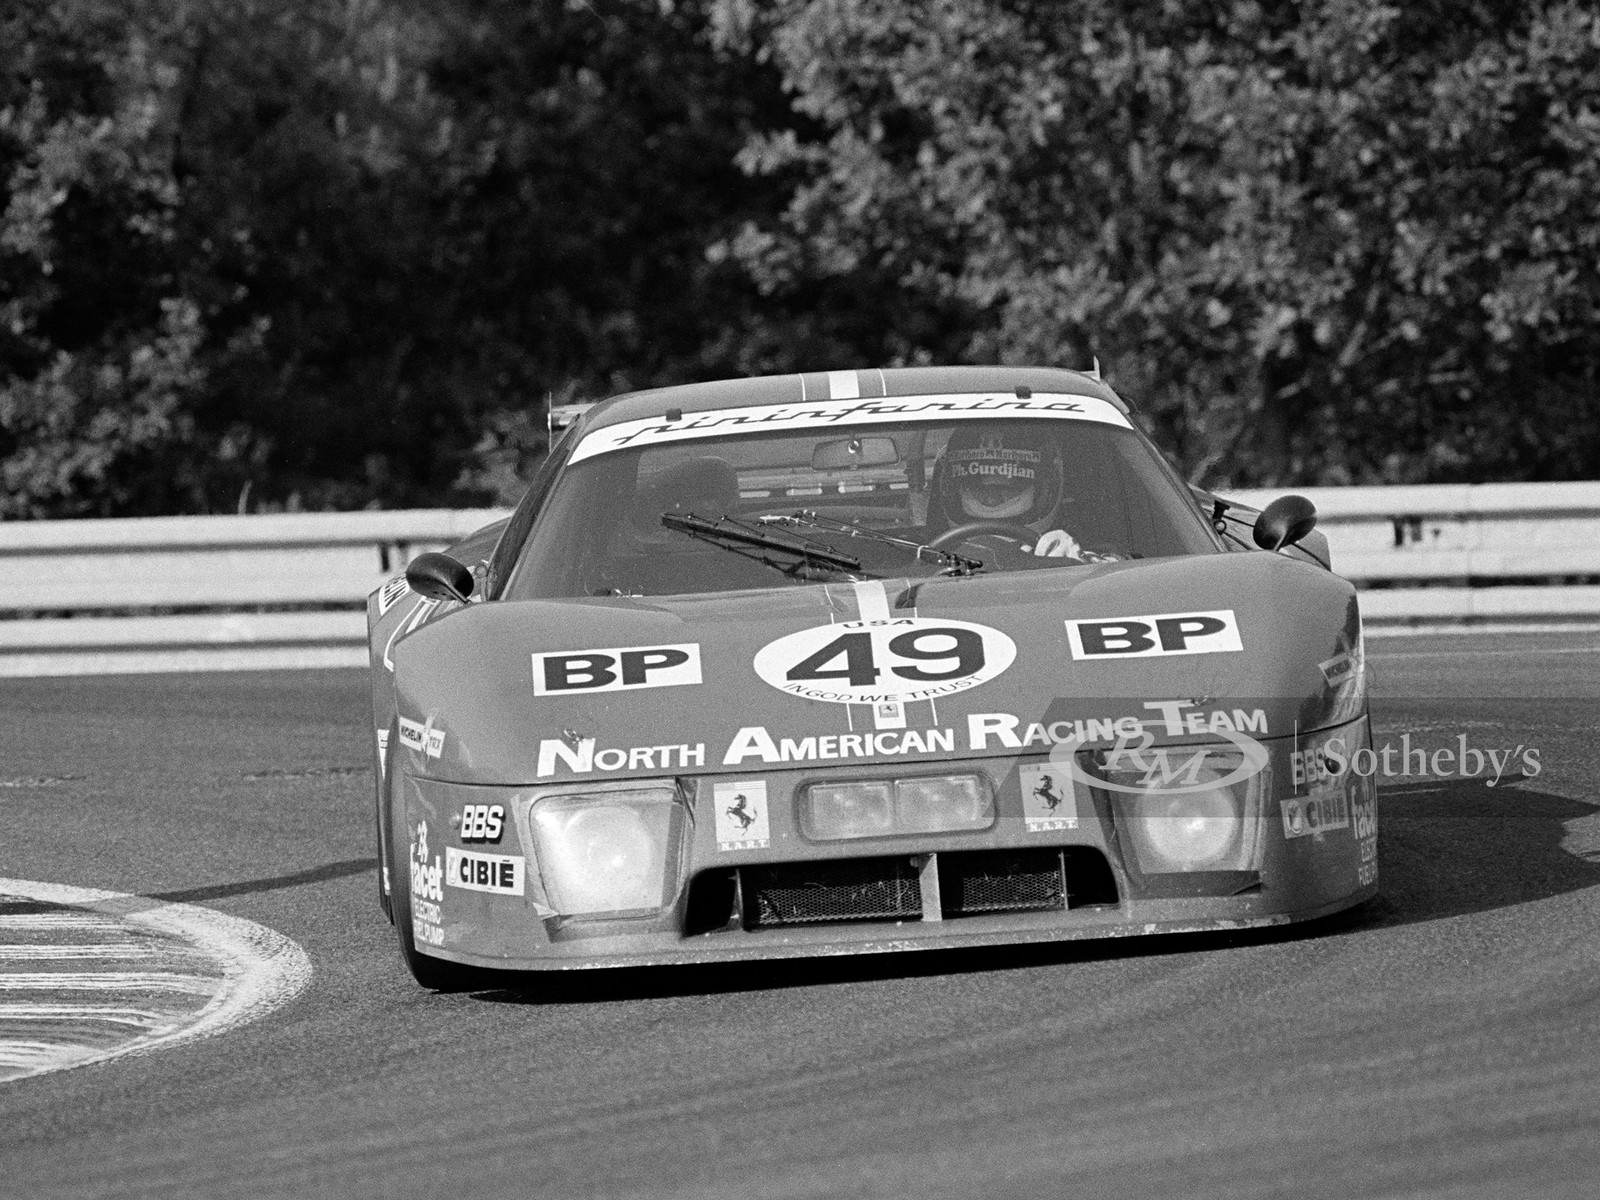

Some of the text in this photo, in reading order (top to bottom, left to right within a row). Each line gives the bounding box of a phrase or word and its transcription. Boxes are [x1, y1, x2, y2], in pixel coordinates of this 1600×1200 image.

[613, 398, 1085, 446] pininfarina
[968, 461, 1035, 479] Gurdjian
[843, 618, 915, 629] USA
[1077, 616, 1226, 655] BP
[543, 649, 690, 691] BP
[786, 627, 986, 687] 49
[859, 693, 899, 702] WE
[905, 674, 985, 699] TRUST
[461, 804, 505, 841] BBS
